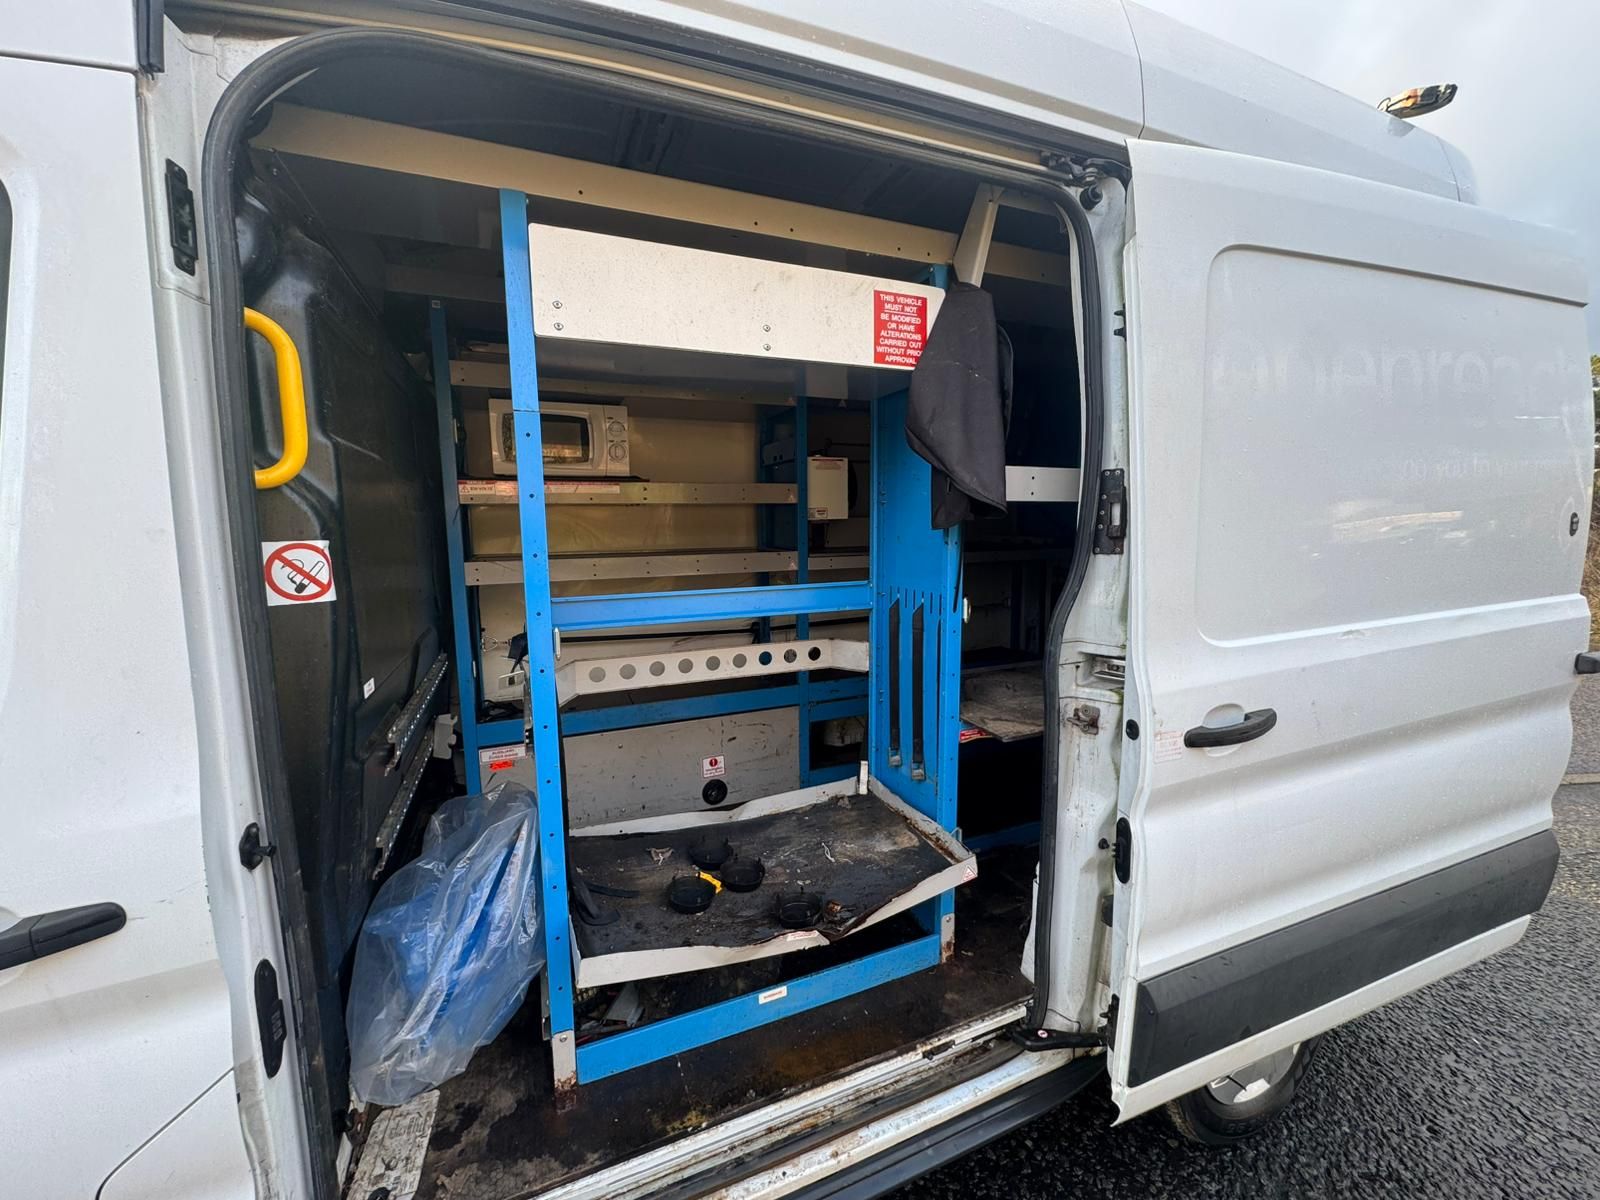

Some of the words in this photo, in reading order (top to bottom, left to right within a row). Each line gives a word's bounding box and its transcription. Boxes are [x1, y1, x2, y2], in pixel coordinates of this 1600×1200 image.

[896, 297, 922, 306] VEHICLE
[892, 315, 921, 324] MODIFIED
[880, 330, 922, 340] ALTERATIONS
[880, 338, 907, 346] CARRIED
[876, 346, 904, 355] WITHOUT
[884, 356, 916, 365] APPROVAL
